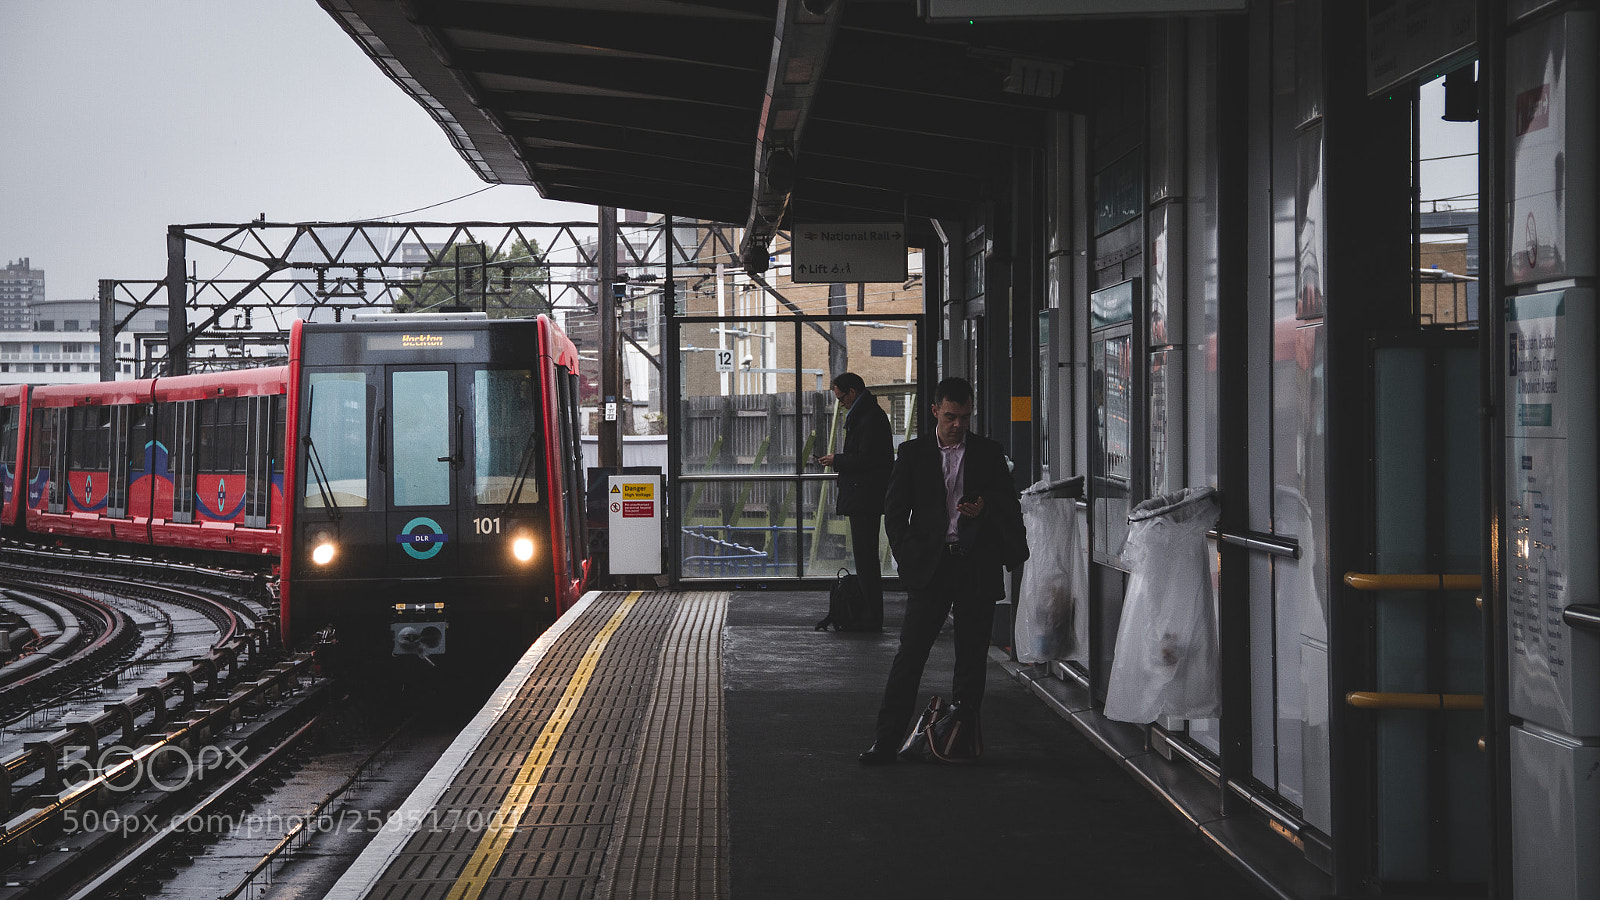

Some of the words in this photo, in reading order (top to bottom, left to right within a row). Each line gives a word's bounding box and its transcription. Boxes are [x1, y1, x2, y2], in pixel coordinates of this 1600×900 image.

[821, 231, 867, 241] National
[870, 231, 890, 241] Rail
[809, 264, 828, 274] Lift
[402, 334, 443, 347] Beckton
[718, 351, 732, 365] 12
[1533, 356, 1541, 376] City
[473, 517, 501, 535] 101
